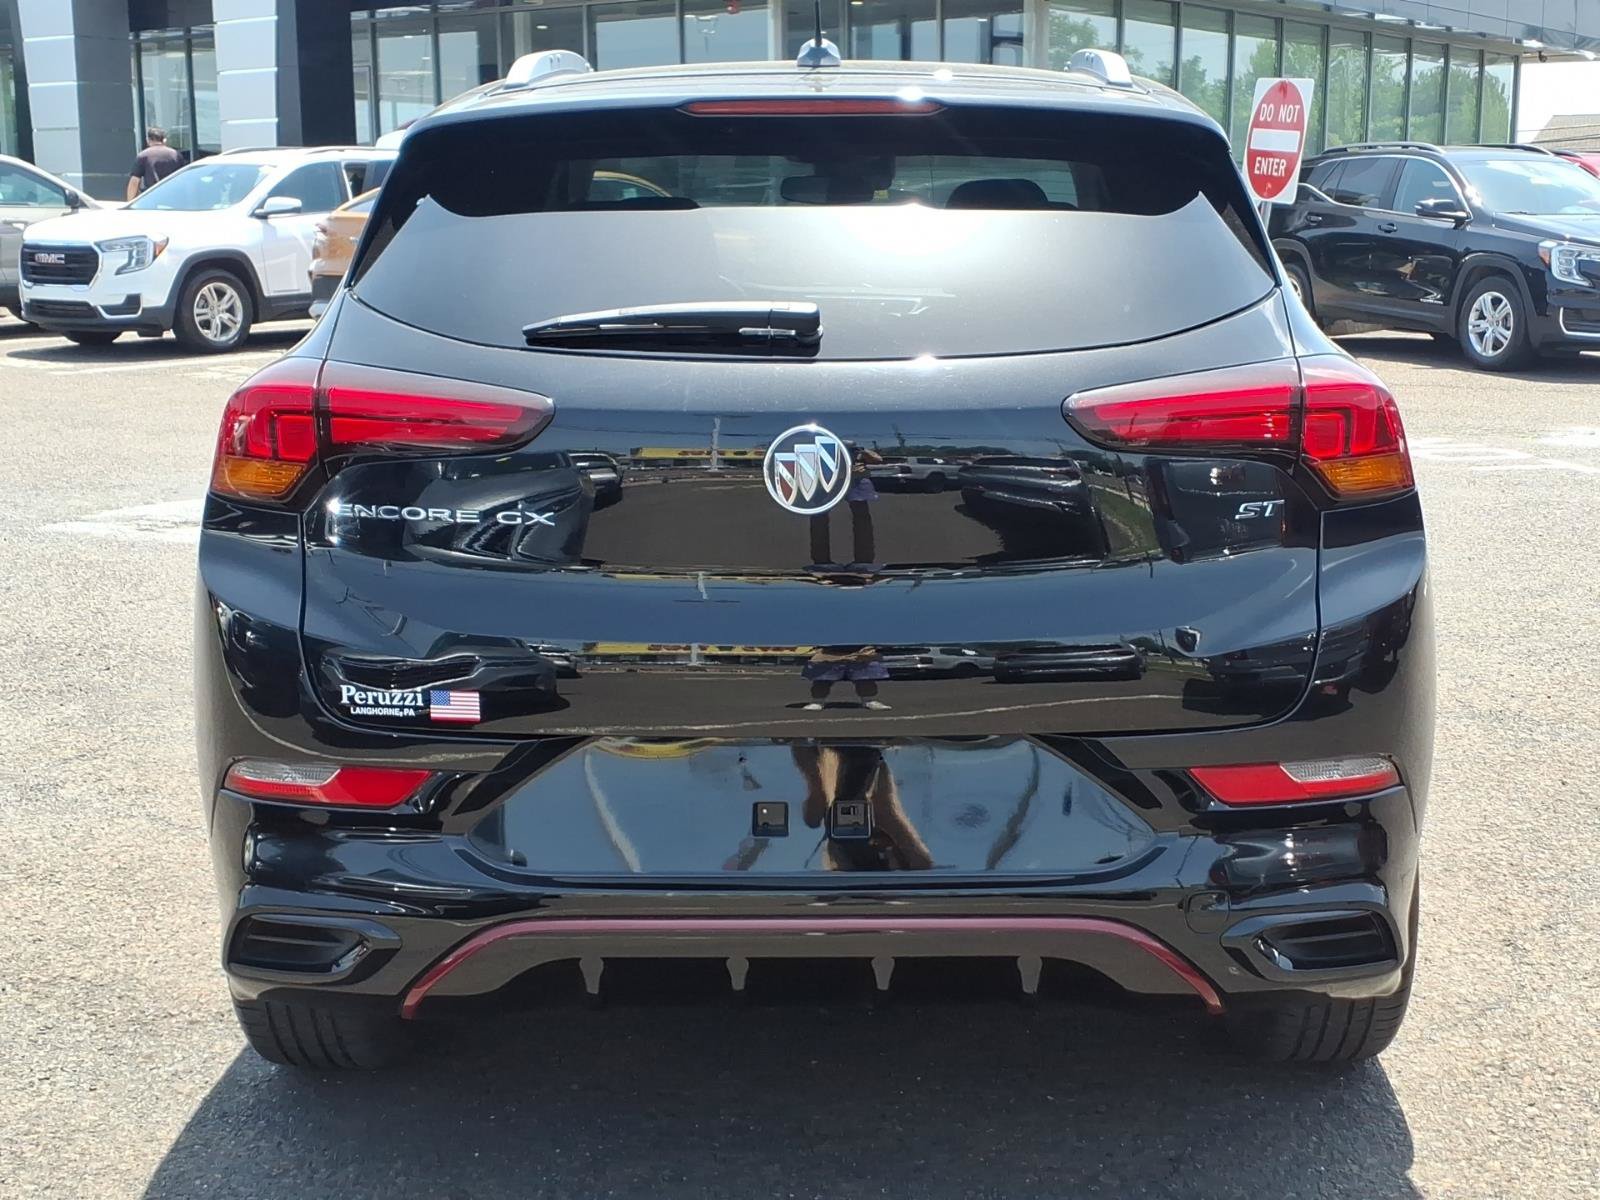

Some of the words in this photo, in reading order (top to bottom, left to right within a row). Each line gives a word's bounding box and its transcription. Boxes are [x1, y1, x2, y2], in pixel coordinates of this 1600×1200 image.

[1259, 103, 1275, 122] DO
[1278, 104, 1300, 123] NOT
[1254, 156, 1287, 177] ENTER
[34, 253, 65, 265] GMC
[336, 503, 480, 523] ENCORE
[496, 511, 555, 526] GX
[1234, 499, 1285, 520] ST
[339, 684, 424, 706] Peruzzi
[404, 709, 416, 717] PA
